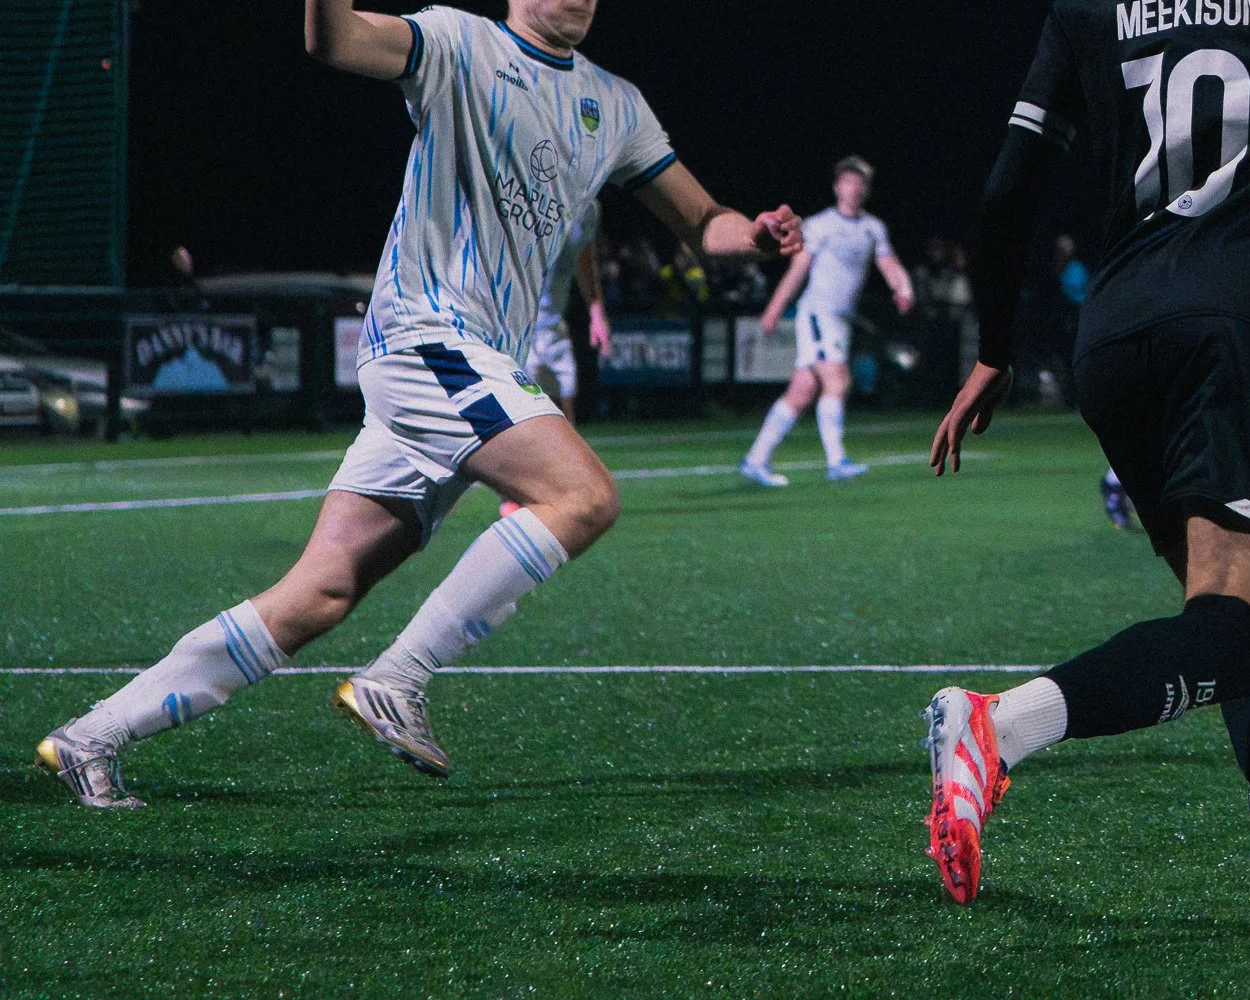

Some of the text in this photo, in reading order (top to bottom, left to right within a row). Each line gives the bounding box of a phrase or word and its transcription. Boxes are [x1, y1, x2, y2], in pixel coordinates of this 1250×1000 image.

[1121, 49, 1250, 220] 10
[495, 171, 565, 222] MAPLES
[497, 198, 554, 238] GROUP
[1196, 679, 1217, 705] 19
